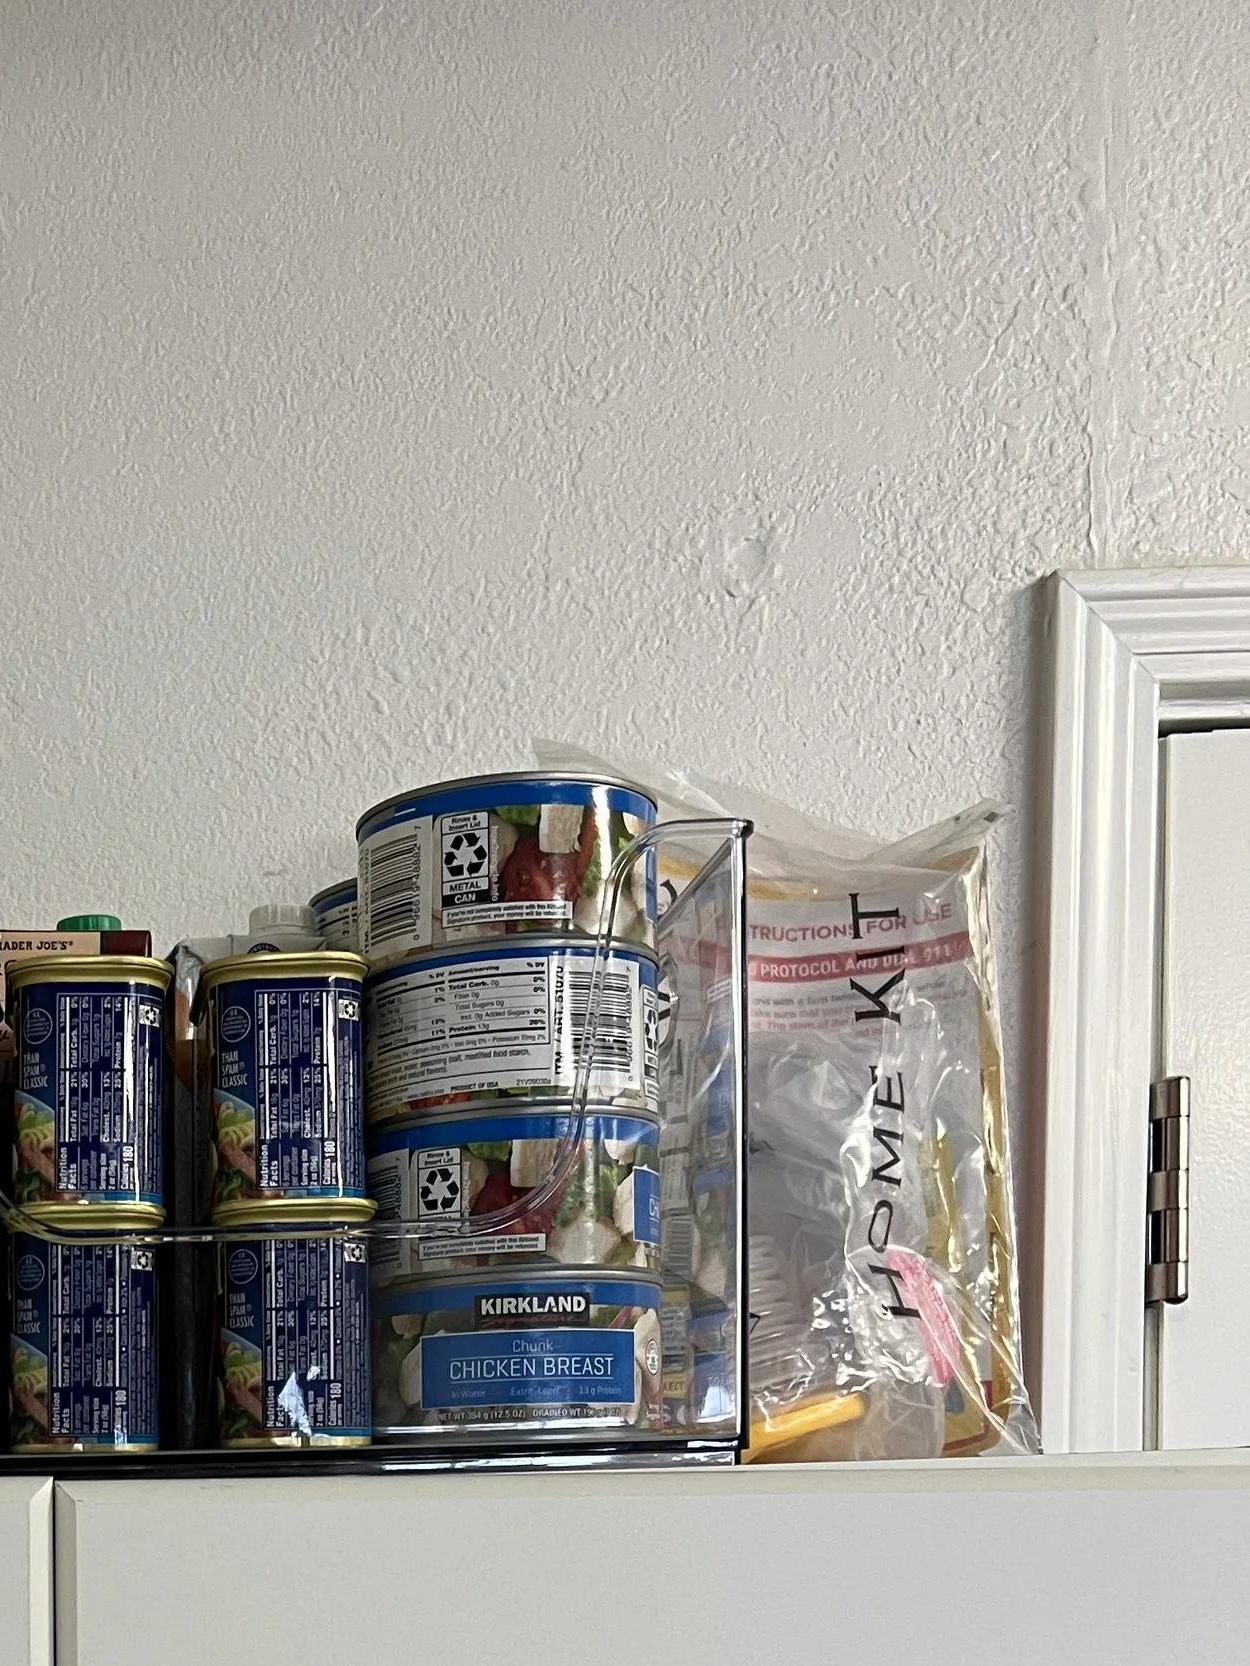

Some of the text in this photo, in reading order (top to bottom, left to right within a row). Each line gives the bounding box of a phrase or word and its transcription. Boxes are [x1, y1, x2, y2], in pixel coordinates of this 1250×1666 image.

[449, 881, 481, 892] METAL
[454, 893, 476, 904] CAN
[866, 915, 907, 934] FOR
[760, 960, 840, 977] PROTOCOL
[448, 982, 469, 991] Total
[470, 981, 489, 989] Carb.
[472, 1001, 494, 1010] Sugars
[449, 1025, 476, 1033] Protein
[24, 1076, 48, 1089] CLASSIC
[222, 1073, 248, 1088] CLASSIC
[450, 1083, 476, 1092] PRODUCT
[848, 893, 922, 1318] HOME KIT
[123, 1146, 134, 1162] 180
[324, 1141, 335, 1157] 180
[59, 1147, 67, 1189] Nutrition
[260, 1144, 268, 1187] Nutrition
[270, 1160, 278, 1187] Facts
[68, 1164, 77, 1189] Facts
[481, 1296, 586, 1315] KIRKLAND
[230, 1316, 254, 1329] CLASSIC
[512, 1339, 554, 1353] Chunk
[450, 1357, 614, 1380] CHICKEN BREAST
[115, 1390, 127, 1406] 180
[330, 1383, 342, 1399] 180
[597, 1386, 621, 1394] Protein
[52, 1392, 60, 1434] Nutrition
[266, 1385, 274, 1427] Nutrition
[454, 1412, 466, 1420] WT
[467, 1411, 482, 1419] 354
[490, 1410, 511, 1420] (12.5
[532, 1408, 568, 1417] DRAINED
[569, 1408, 581, 1416] WT
[61, 1408, 70, 1434] Facts
